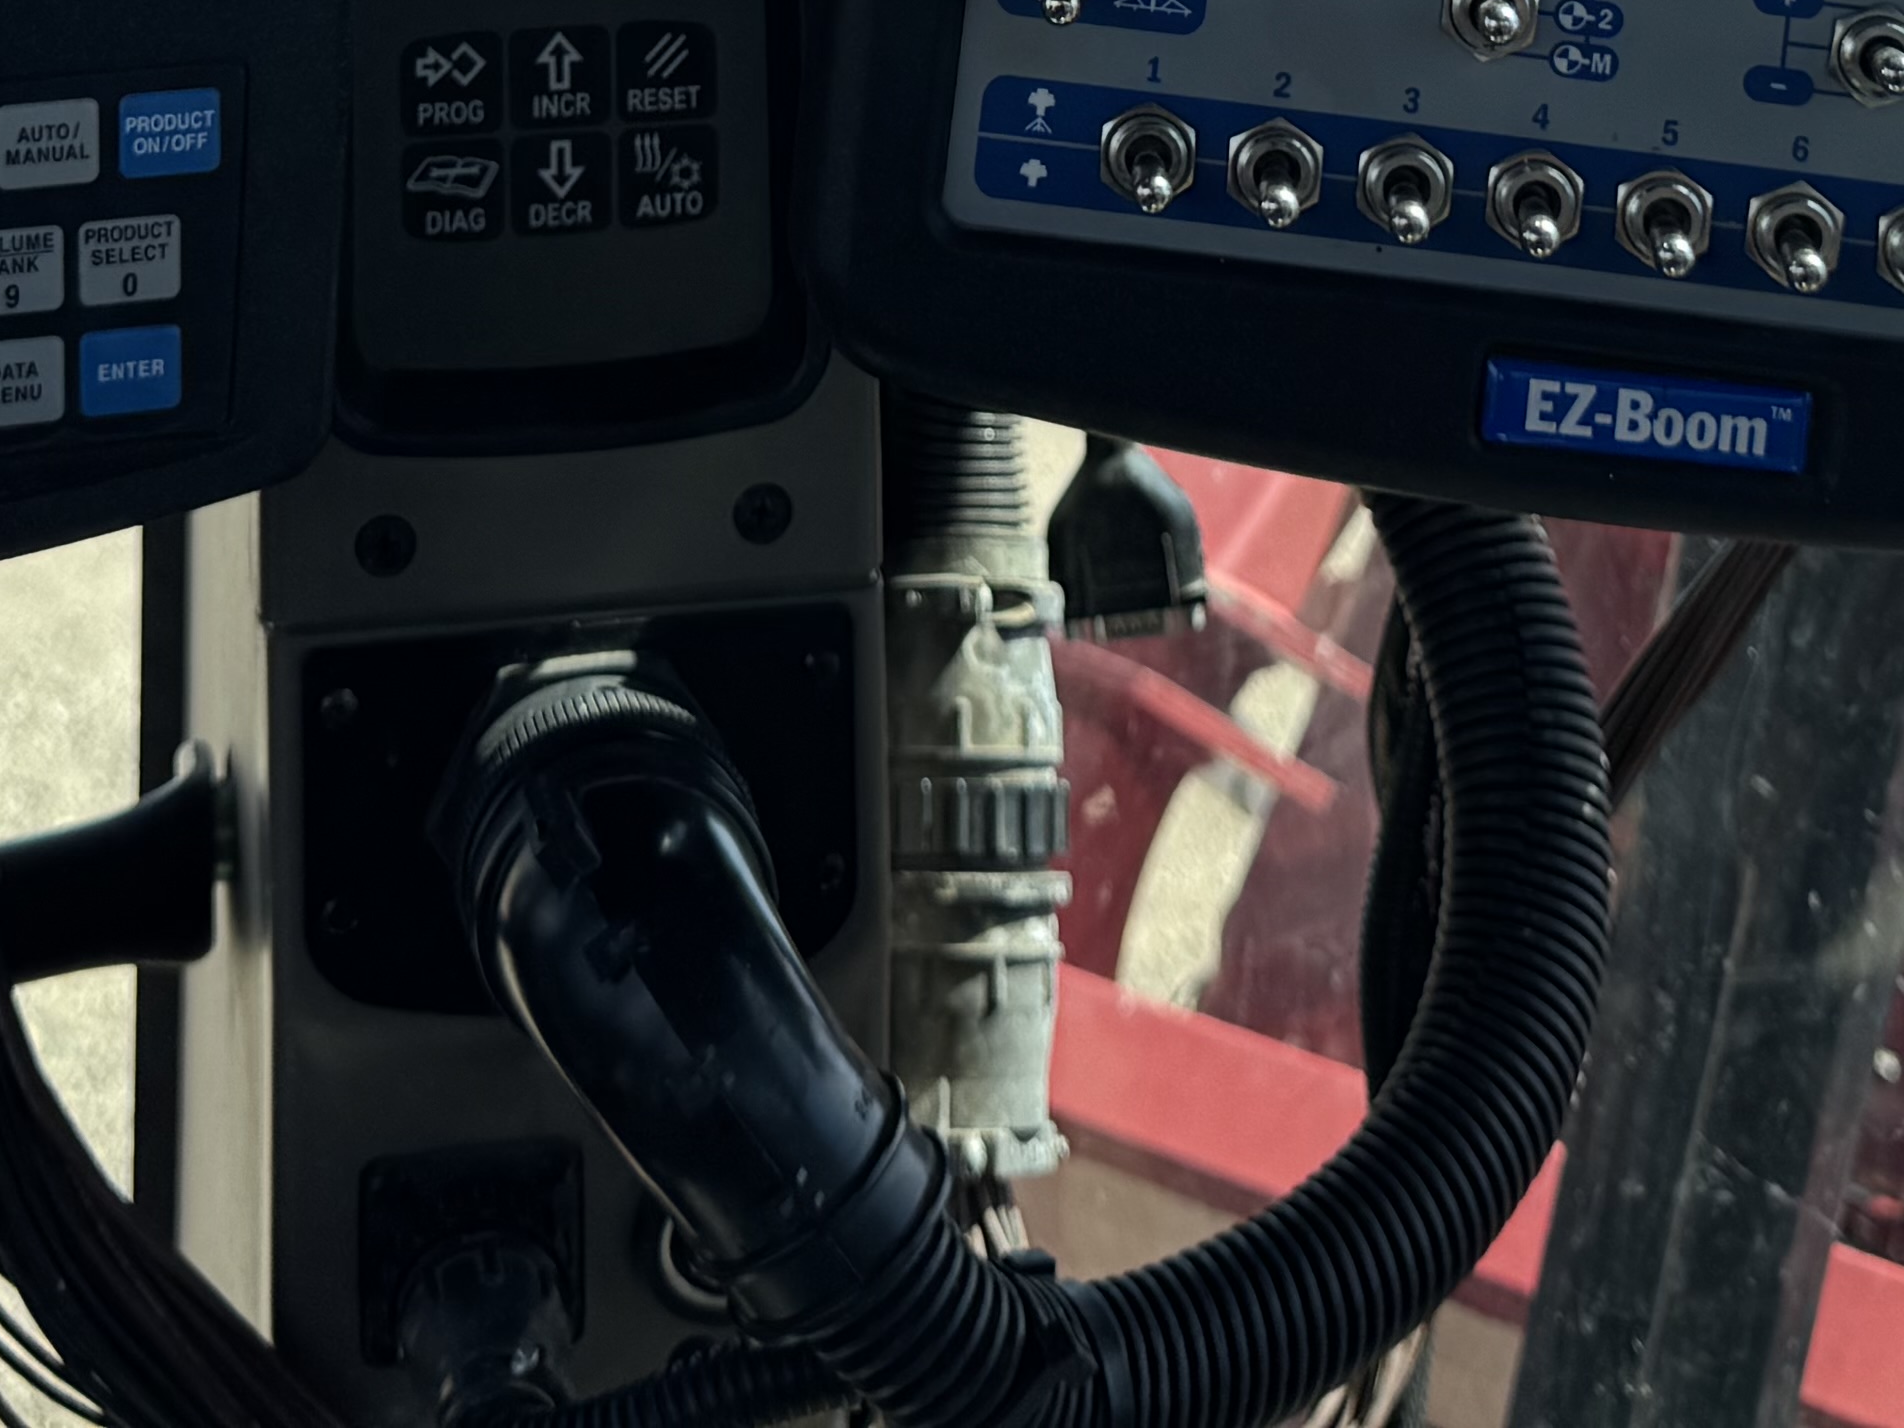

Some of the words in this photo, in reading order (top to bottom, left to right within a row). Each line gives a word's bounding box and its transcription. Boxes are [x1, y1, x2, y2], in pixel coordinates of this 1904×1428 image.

[1599, 8, 1614, 30] 2
[1591, 52, 1613, 77] M
[532, 92, 592, 120] INCR
[626, 85, 702, 113] RESET
[1147, 56, 1162, 82] 1
[1274, 72, 1292, 98] 2
[1403, 87, 1421, 114] 3
[1531, 103, 1550, 130] 4
[1662, 119, 1680, 147] 5
[1791, 136, 1809, 163] 6
[125, 109, 216, 134] PRODUCT
[417, 99, 485, 127] PROG
[17, 121, 80, 144] AUTO/
[133, 132, 208, 155] ON/OFF
[5, 143, 90, 167] MANUAL
[528, 200, 592, 228] DECR
[635, 190, 704, 219] AUTO
[84, 220, 175, 244] PRODUCT
[425, 208, 487, 235] DIAG
[91, 244, 169, 267] SELECT
[4, 283, 20, 309] 9
[122, 272, 138, 297] 0
[97, 358, 165, 383] ENTER
